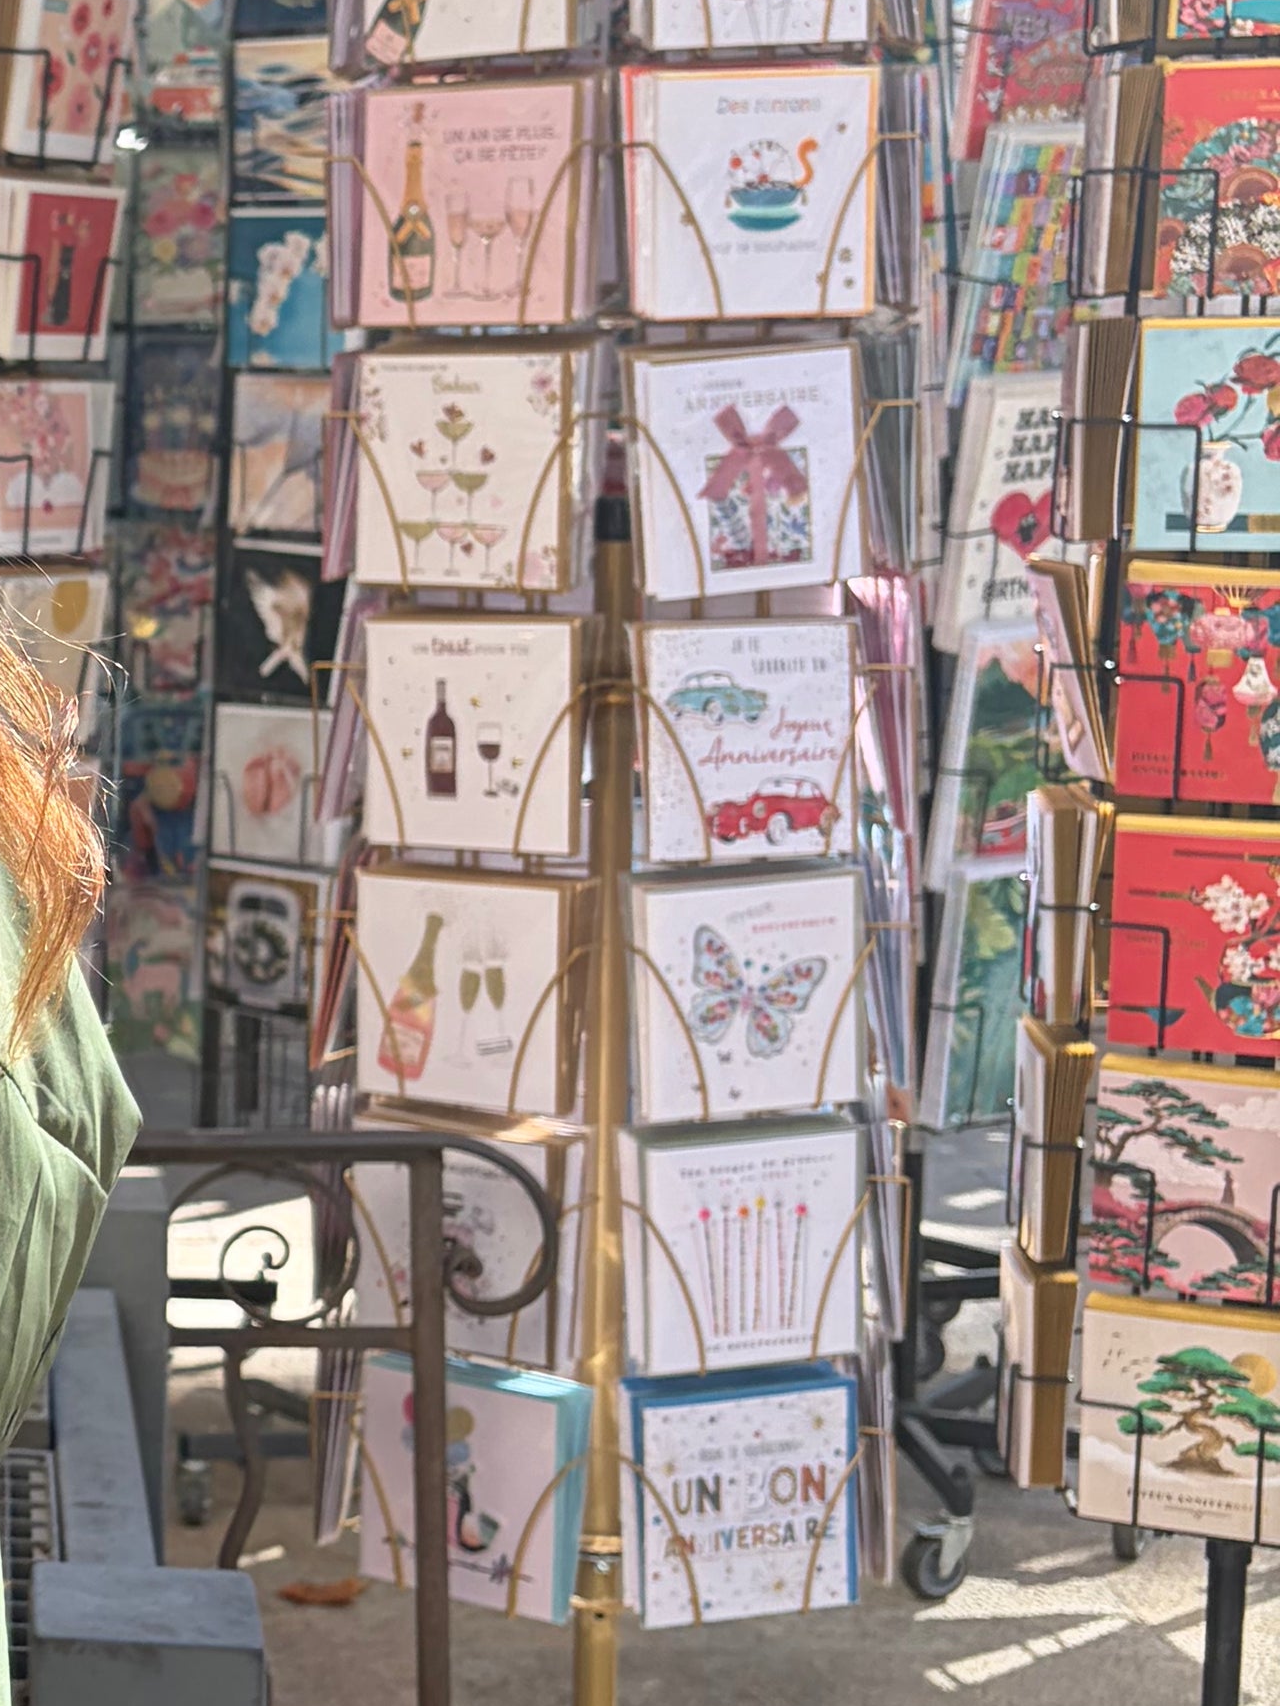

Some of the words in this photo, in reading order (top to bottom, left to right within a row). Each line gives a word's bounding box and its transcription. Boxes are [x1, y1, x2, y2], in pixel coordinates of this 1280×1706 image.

[769, 705, 835, 743] Joyeux
[697, 735, 840, 772] Anniversaire
[672, 1474, 722, 1515] UN
[745, 1464, 827, 1510] BON
[664, 1516, 837, 1558] ANIVERSARE
